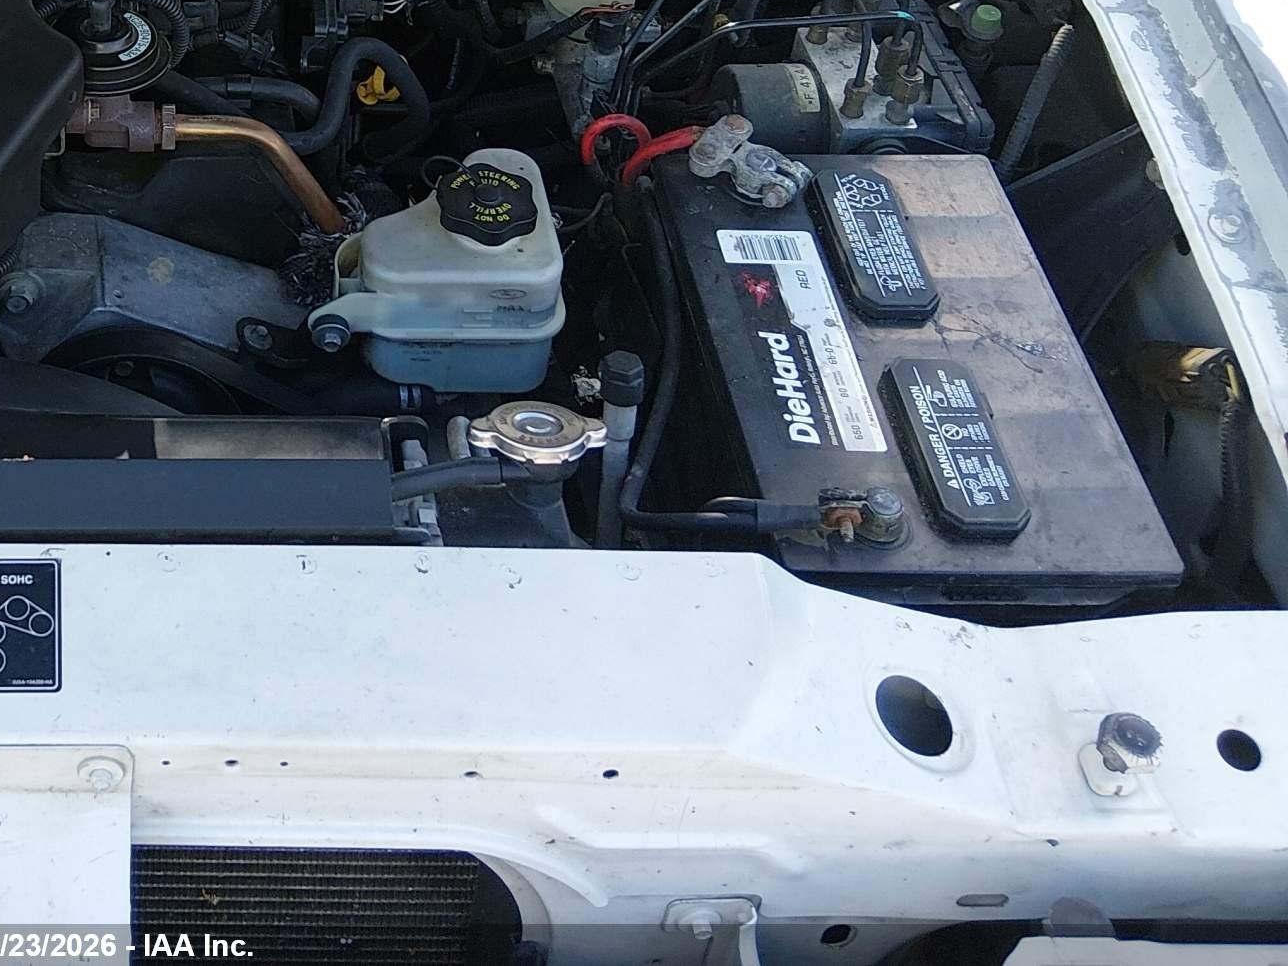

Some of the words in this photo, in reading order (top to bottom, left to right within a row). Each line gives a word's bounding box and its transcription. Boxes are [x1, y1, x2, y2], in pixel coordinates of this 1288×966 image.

[478, 171, 520, 189] STEERING
[469, 202, 512, 214] OVERFILL
[868, 248, 878, 259] EYES
[880, 243, 890, 254] HELP
[873, 260, 885, 275] FLUSH
[881, 263, 892, 274] WITH
[885, 256, 899, 274] MEDICAL
[936, 369, 948, 381] ACID
[756, 329, 822, 445] DieHard
[813, 384, 821, 393] Auto
[816, 395, 828, 412] Advance
[908, 385, 934, 423] POISON
[825, 421, 838, 445] Distributed
[960, 427, 970, 436] NO
[927, 433, 955, 477] DANGER
[954, 453, 969, 473] SHIELD
[964, 458, 976, 473] EYES
[970, 456, 989, 486] EXPLOSIVE
[1, 574, 33, 584] SOHC
